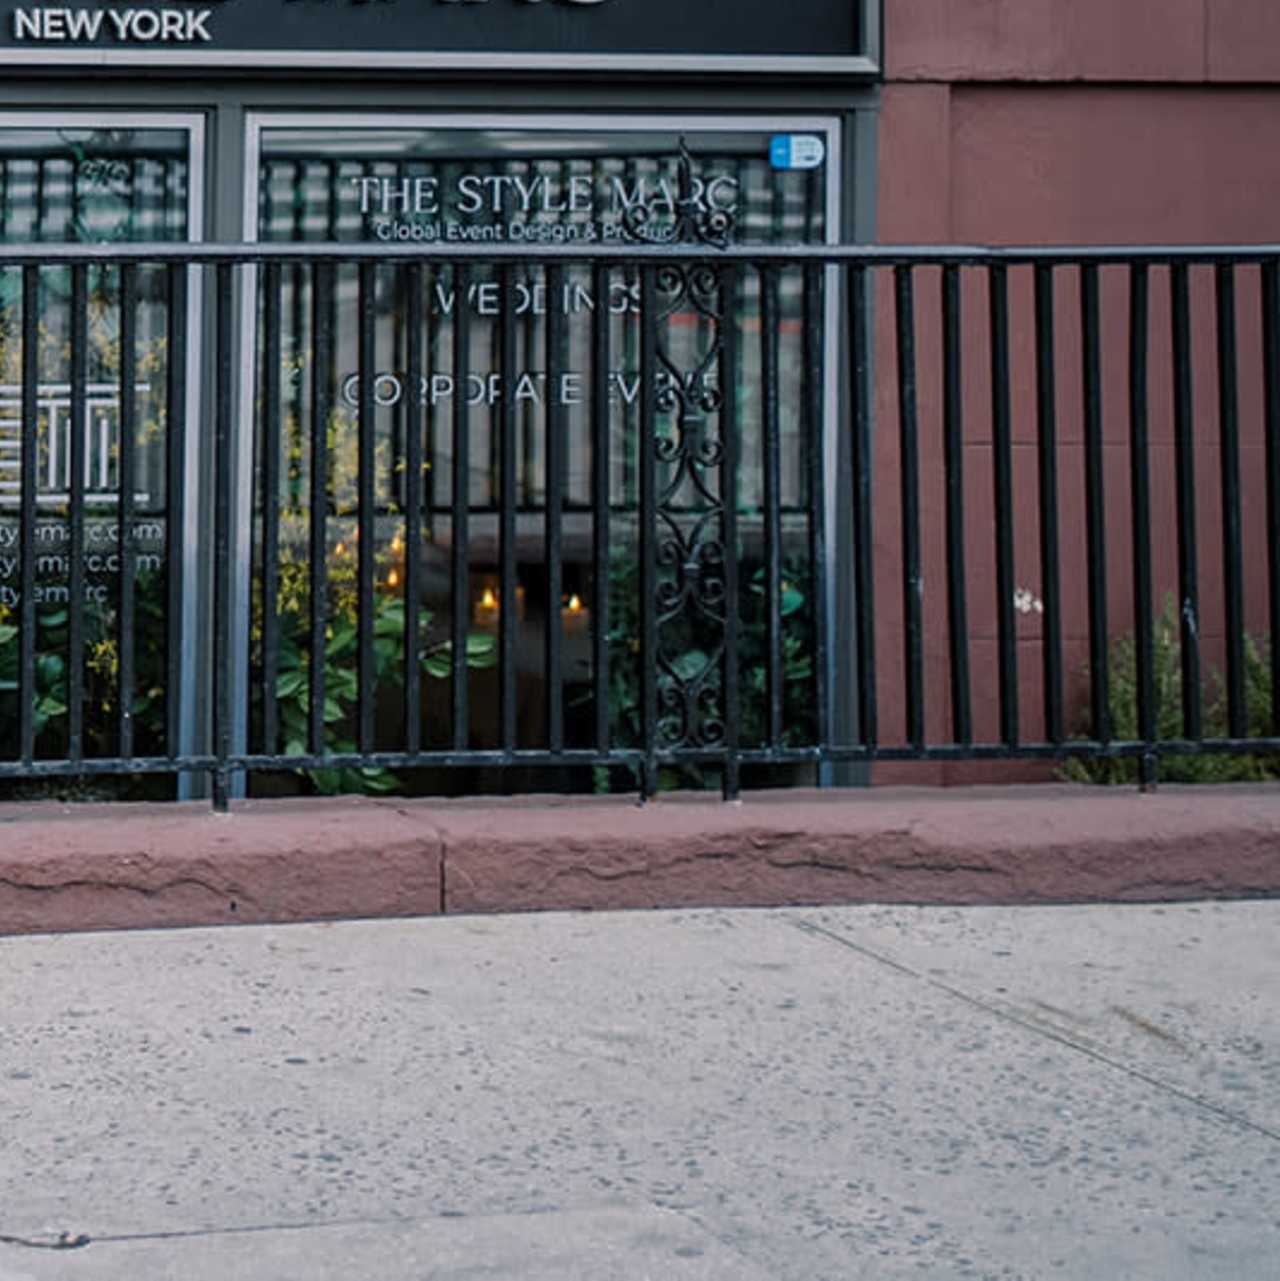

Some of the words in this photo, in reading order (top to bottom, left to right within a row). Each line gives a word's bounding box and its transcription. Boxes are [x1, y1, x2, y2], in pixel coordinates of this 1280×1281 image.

[14, 8, 102, 41] NEW
[111, 9, 213, 42] YORK
[351, 176, 439, 214] THE
[456, 176, 593, 214] STYLE
[611, 177, 739, 214] MARC
[376, 221, 440, 242] Global
[446, 222, 503, 241] Event
[508, 222, 584, 245] Design
[586, 222, 597, 240] &
